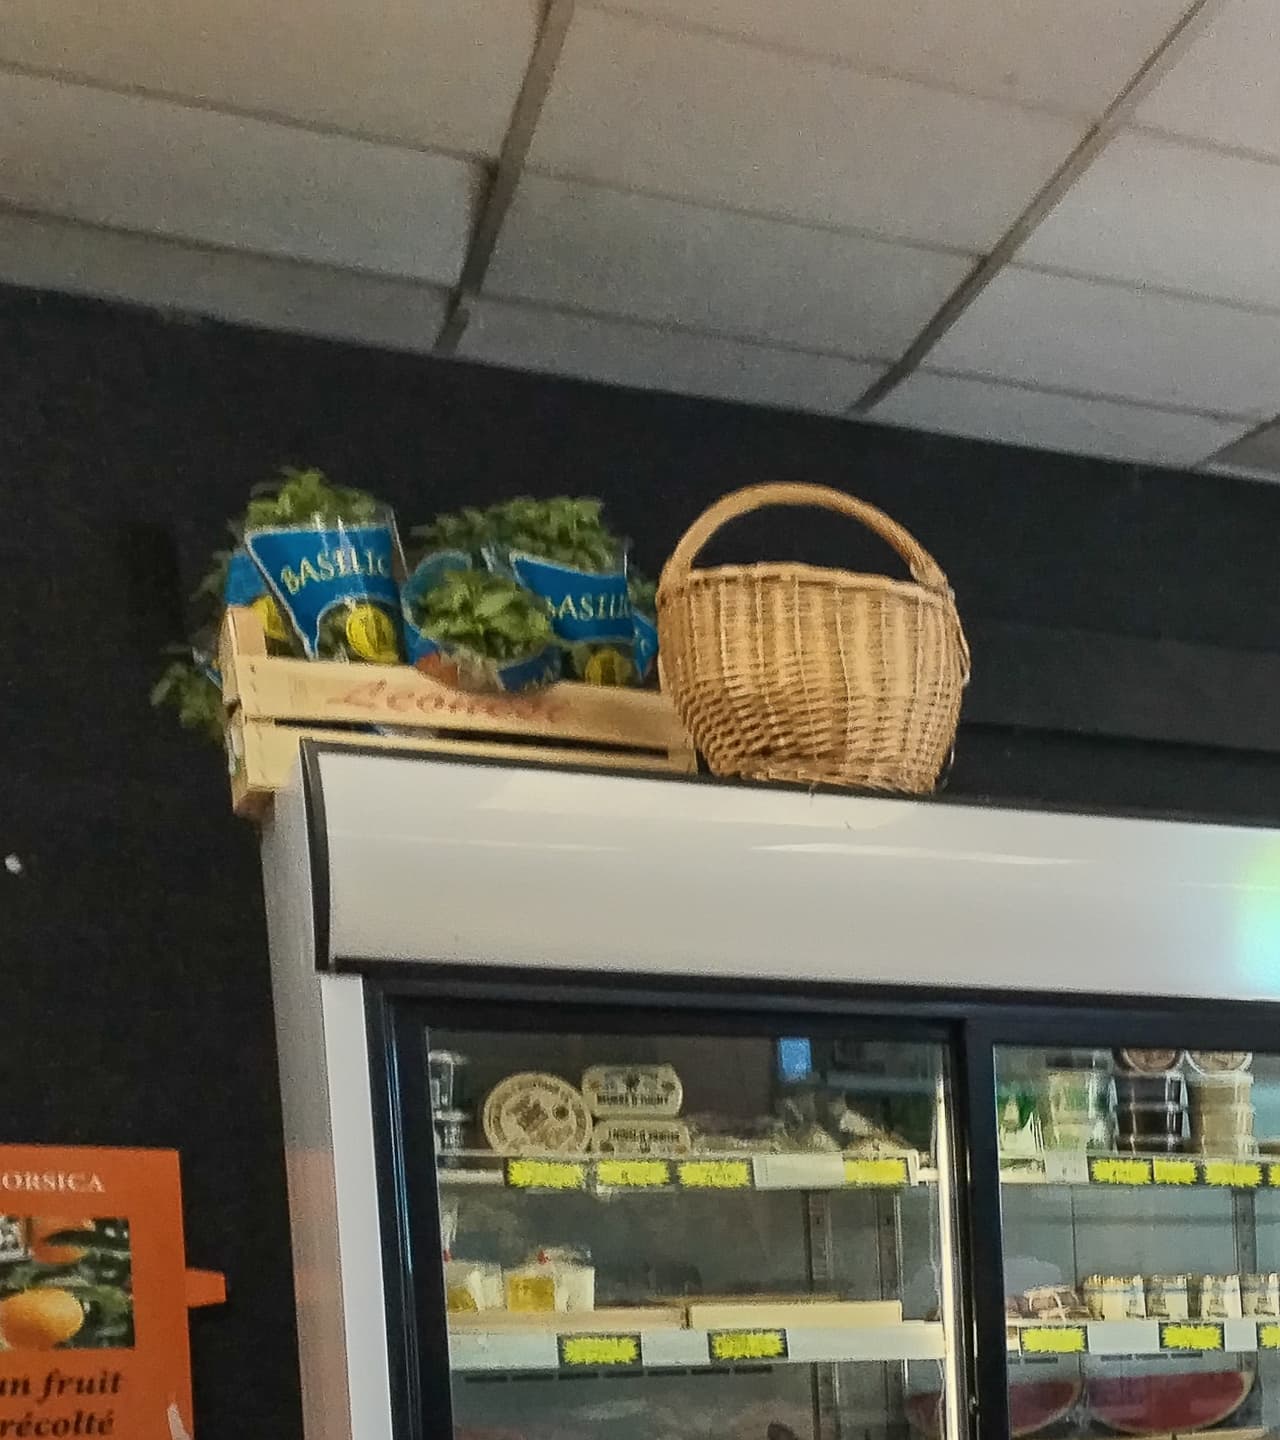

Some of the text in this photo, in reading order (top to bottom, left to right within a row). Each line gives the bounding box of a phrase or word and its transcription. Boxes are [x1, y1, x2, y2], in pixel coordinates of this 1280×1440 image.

[281, 547, 389, 596] BASILIC
[0, 1171, 106, 1194] ORSICA
[38, 1368, 123, 1405] fruit
[0, 1409, 115, 1439] récolté
